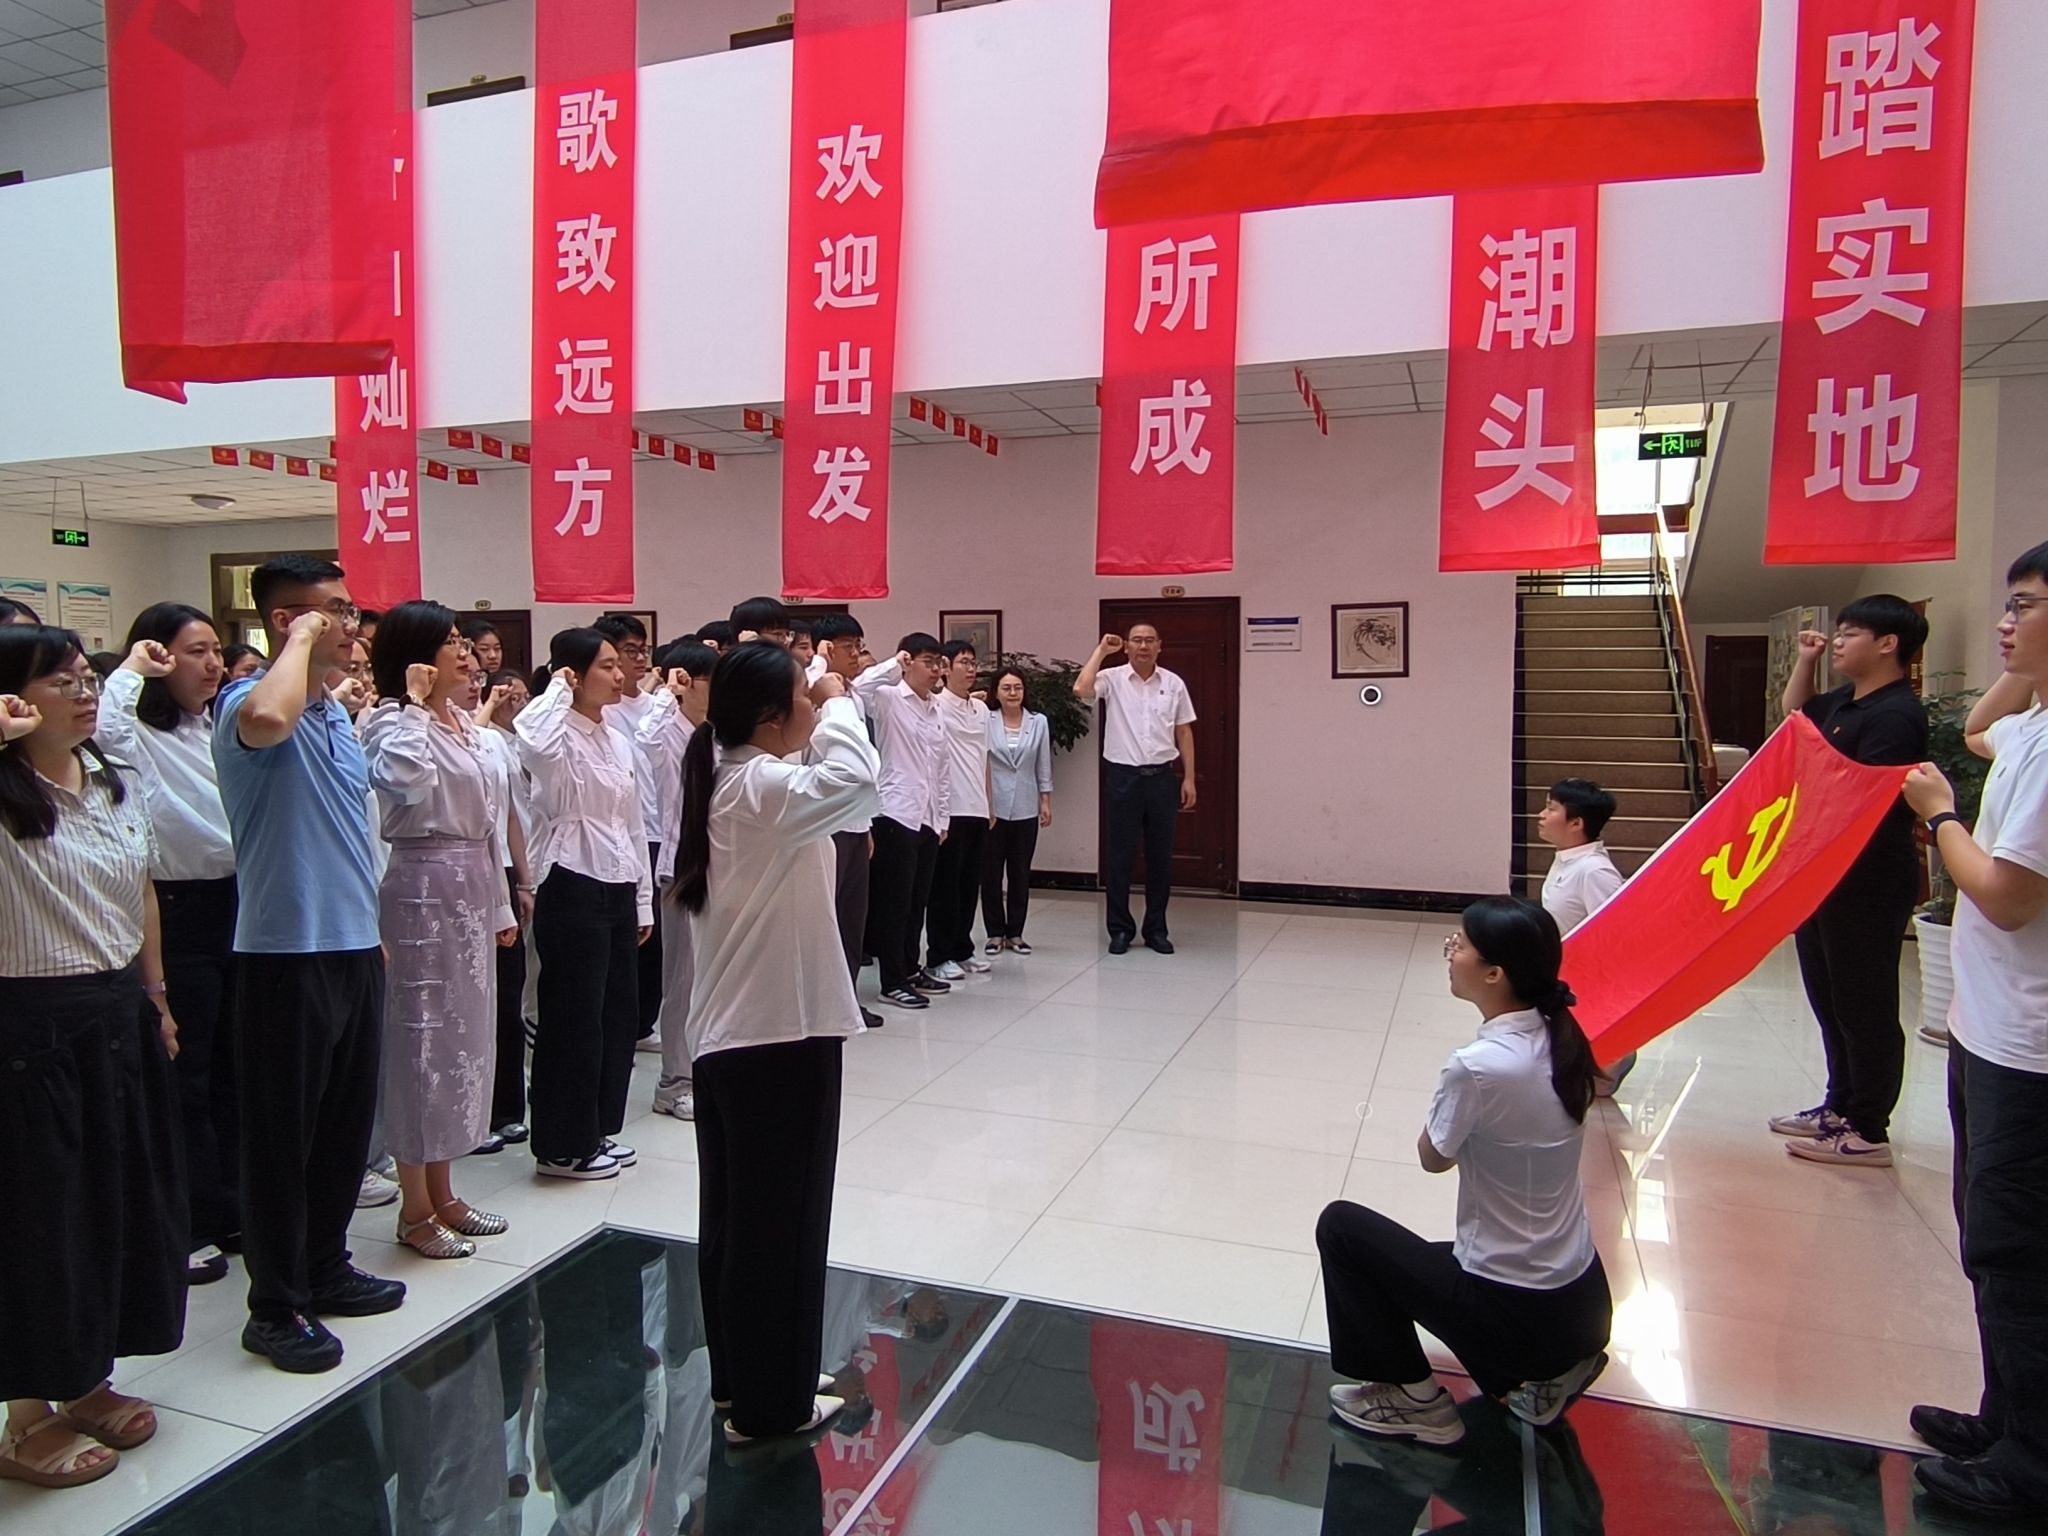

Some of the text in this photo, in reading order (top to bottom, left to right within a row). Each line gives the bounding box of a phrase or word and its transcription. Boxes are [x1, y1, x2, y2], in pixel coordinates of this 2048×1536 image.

[555, 88, 618, 537] 歌致远方
[807, 124, 883, 525] 欢迎出发
[1130, 234, 1218, 475] 所成
[1474, 226, 1577, 511] 潮头
[1803, 16, 1941, 502] 踏实地
